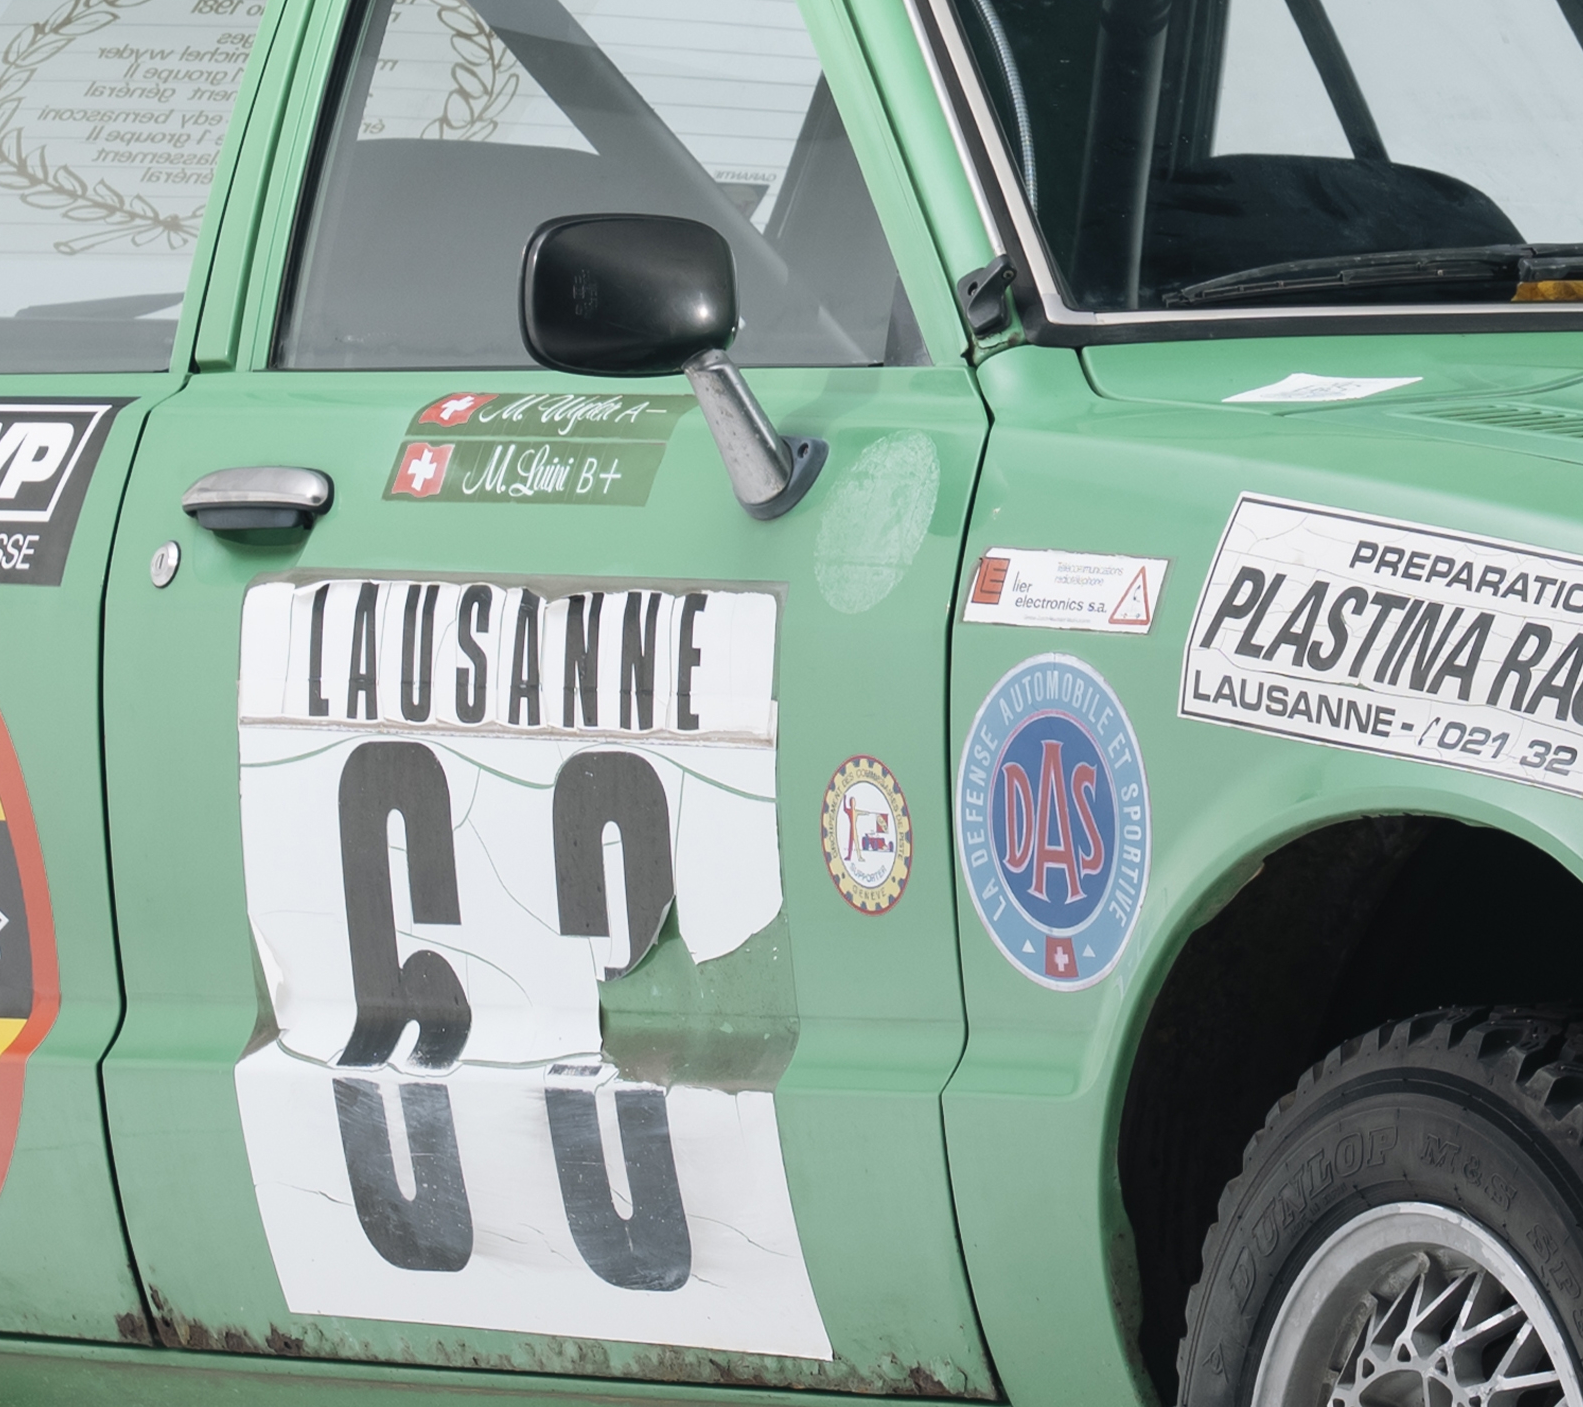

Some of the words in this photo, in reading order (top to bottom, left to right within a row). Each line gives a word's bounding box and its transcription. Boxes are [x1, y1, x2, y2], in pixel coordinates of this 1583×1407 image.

[462, 444, 506, 495] M.
[309, 583, 707, 730] LAUSANNE
[1015, 594, 1084, 612] electronics
[1087, 601, 1107, 613] s.a.
[1199, 565, 1495, 700] PLASTINA
[999, 670, 1114, 736] AUTOMOBILE
[1107, 732, 1132, 767] ET
[1193, 669, 1396, 737] LAUSANNE
[1437, 722, 1510, 759] 021
[1519, 739, 1578, 776] 32
[966, 725, 998, 868] DEFENSE
[1002, 740, 1105, 904] DAS
[1109, 782, 1142, 928] SPORTIVE
[982, 877, 1007, 922] LA
[1229, 1127, 1398, 1315] DUNLOP
